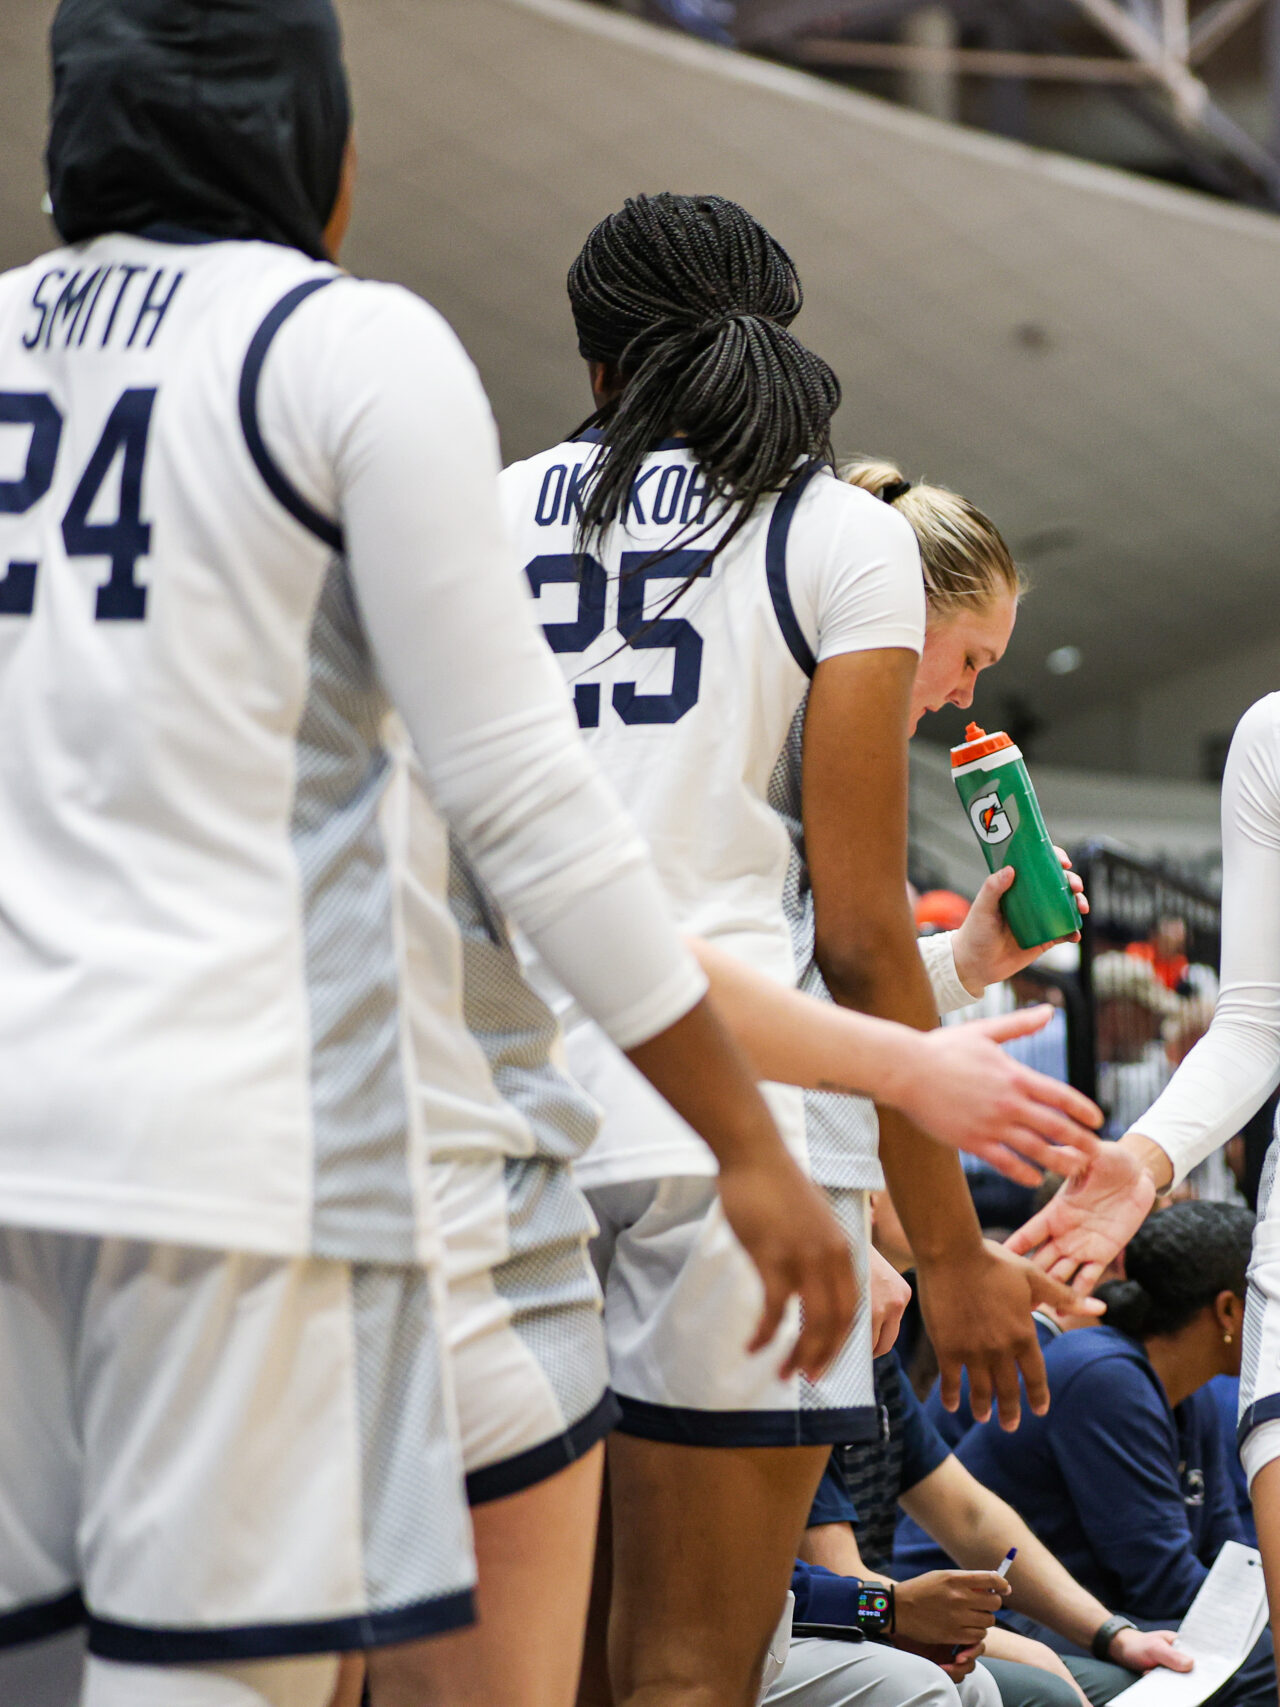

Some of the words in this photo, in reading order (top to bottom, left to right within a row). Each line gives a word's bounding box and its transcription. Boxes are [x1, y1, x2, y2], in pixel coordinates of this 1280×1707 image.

[23, 264, 184, 349] SMITH
[0, 387, 157, 621] 24
[525, 550, 715, 728] 25
